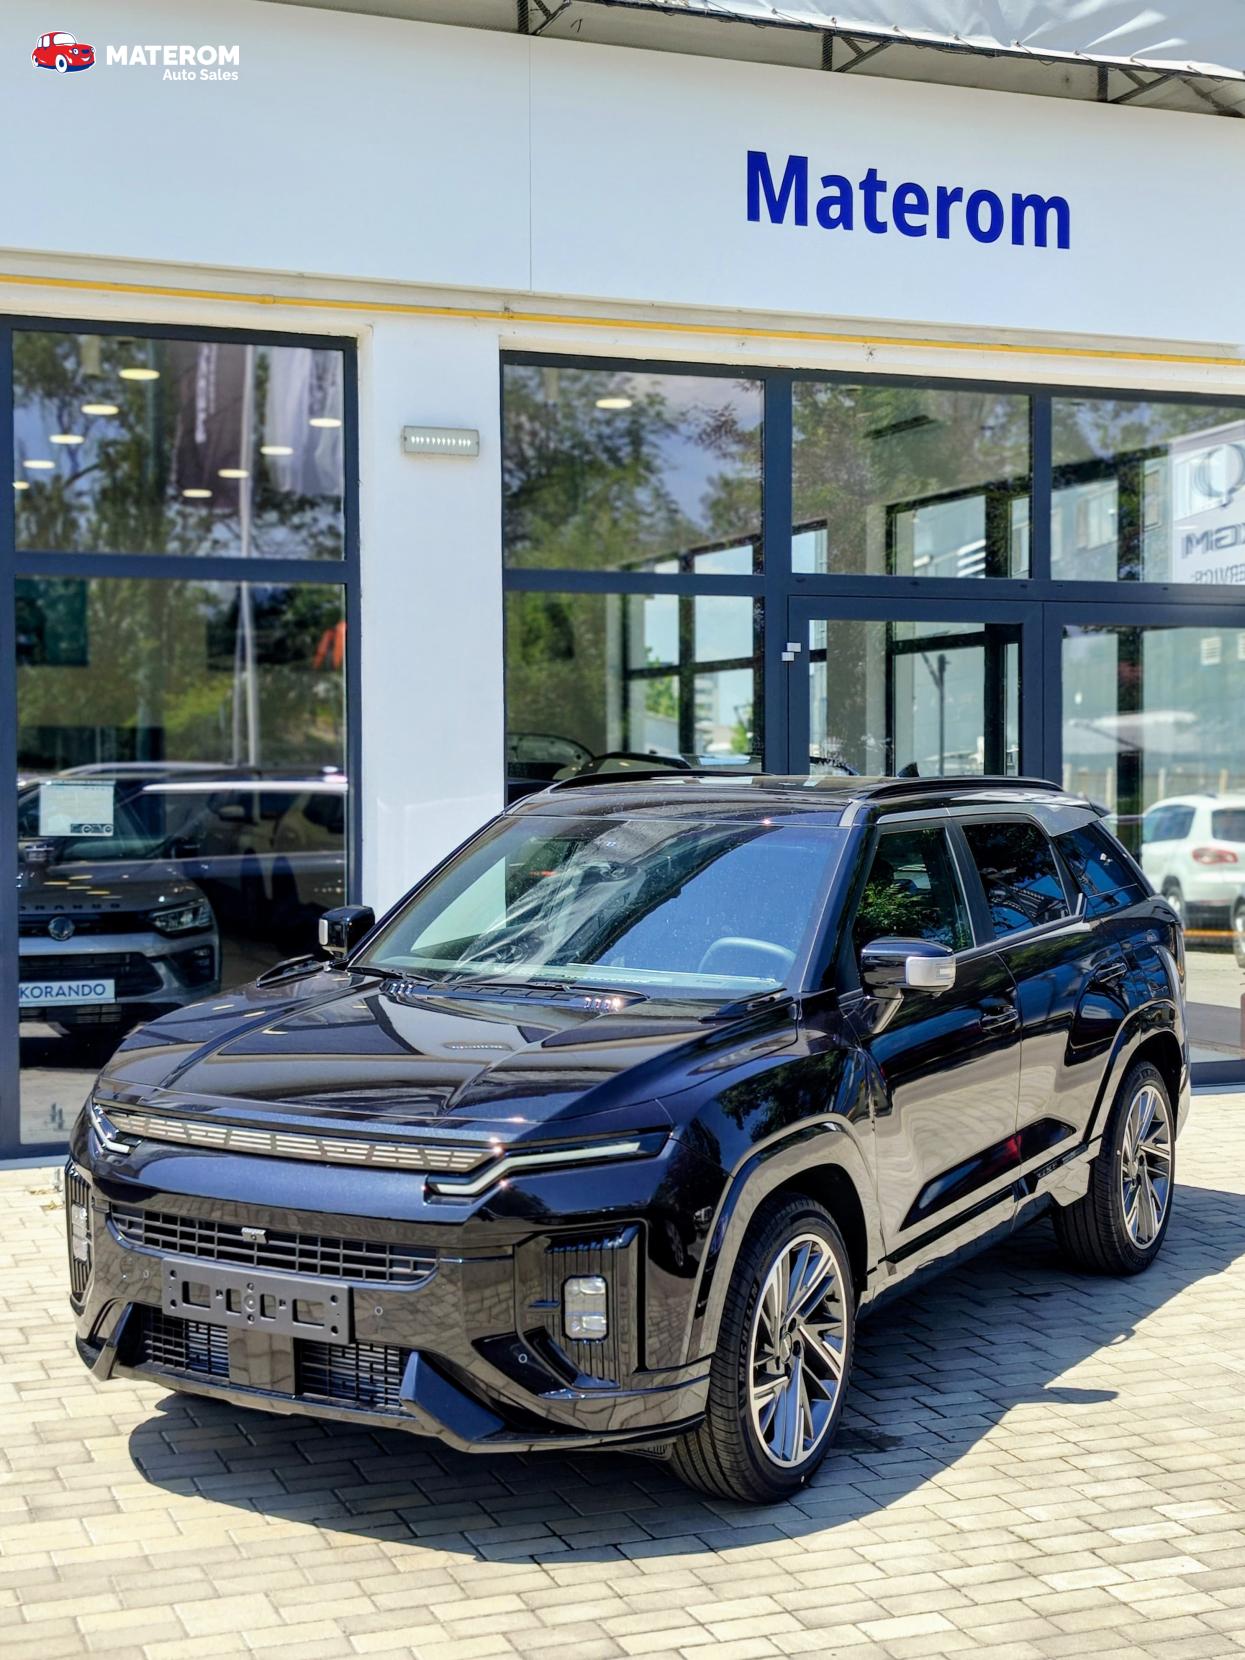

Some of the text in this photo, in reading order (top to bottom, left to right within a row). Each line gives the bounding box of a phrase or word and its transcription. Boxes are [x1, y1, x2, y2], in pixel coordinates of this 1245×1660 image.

[746, 150, 1071, 250] Materom
[19, 983, 106, 999] KORANDO
[738, 1282, 758, 1382] MICHELIN
